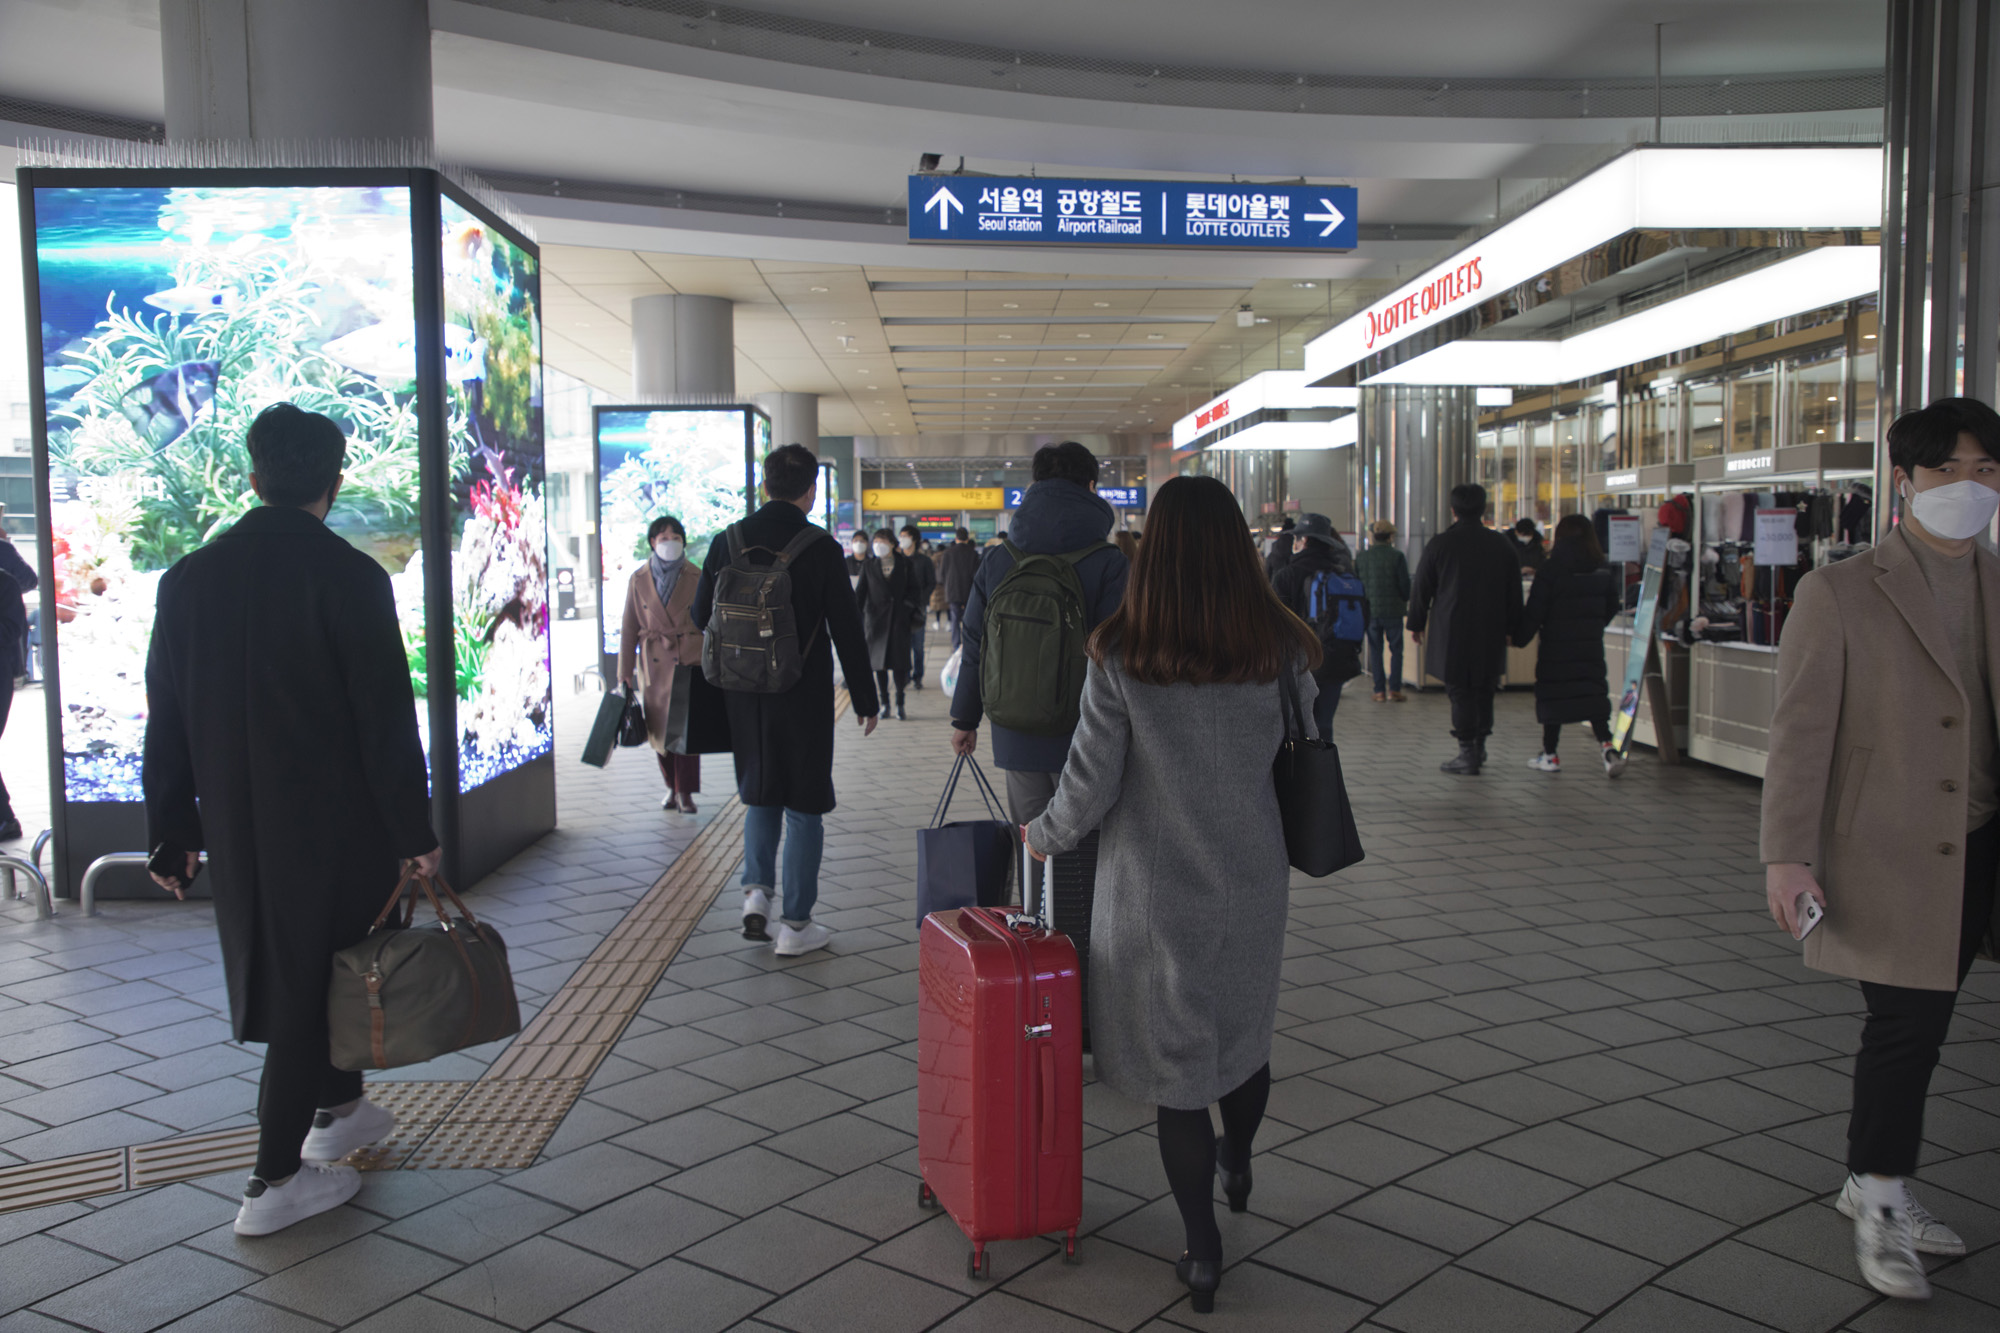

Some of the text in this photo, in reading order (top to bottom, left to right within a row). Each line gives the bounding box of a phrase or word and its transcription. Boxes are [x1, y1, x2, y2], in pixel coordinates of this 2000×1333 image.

[978, 187, 1142, 215] 서울역 공항철도
[1186, 193, 1290, 220] 롯데아울렛
[978, 216, 1042, 232] Seoul station
[1057, 218, 1142, 236] Airport Railroad
[1186, 221, 1290, 238] LOTTE OUTLETS
[1378, 256, 1482, 336] LOTTE OUTLETS
[870, 492, 880, 506] 2
[1011, 490, 1022, 505] 2
